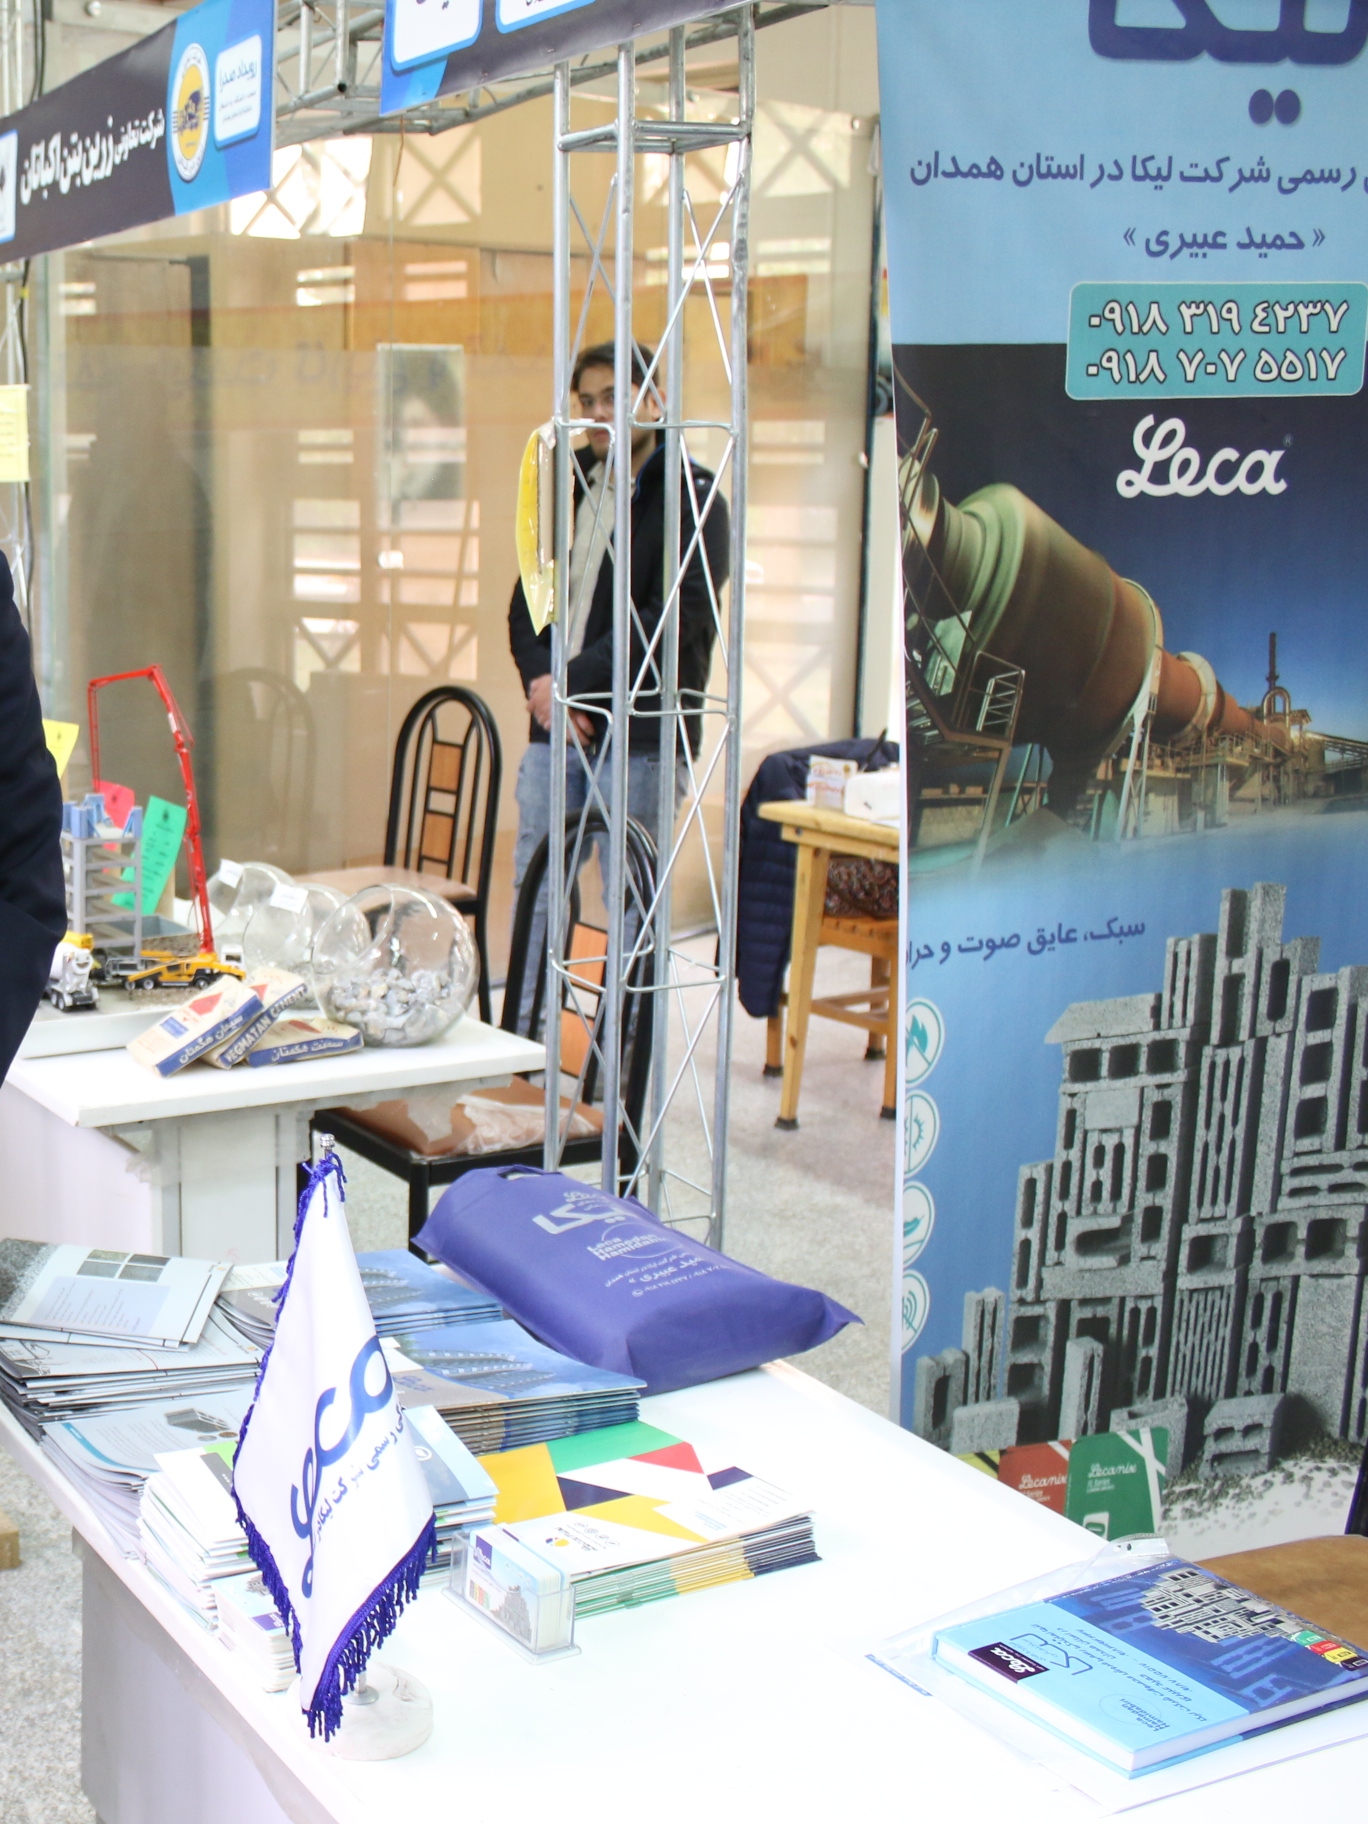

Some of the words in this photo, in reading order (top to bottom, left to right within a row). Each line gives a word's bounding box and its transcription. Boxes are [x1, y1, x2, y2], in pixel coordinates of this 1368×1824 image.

[114, 119, 139, 165] تعاونی
[139, 108, 165, 150] شرکت
[82, 115, 113, 186] زرین
[20, 132, 61, 205] اکباتان
[910, 151, 1004, 187] همدان
[1012, 153, 1084, 187] استان
[1090, 156, 1123, 189] در
[1132, 155, 1173, 190] لیکا
[1179, 155, 1271, 193] شرکت
[1277, 161, 1356, 195] رسمی
[1145, 227, 1227, 259] عبیری
[1236, 227, 1305, 259] حمید
[1088, 300, 1169, 335] ۰۹۱۸
[1179, 300, 1241, 335] ۳۱۹
[1086, 349, 1167, 384] ۰۹۱۸
[1178, 349, 1246, 383] ۷۰۷
[1254, 349, 1345, 383] ۵۵۱۷
[1116, 414, 1287, 498] Leca
[906, 941, 934, 970] حرا
[939, 941, 951, 965] و
[958, 932, 1020, 961] صوت
[1027, 923, 1077, 955] عایق
[270, 985, 307, 1018] CEMENT
[587, 1237, 622, 1251] Leca
[592, 1234, 658, 1256] Hamedan
[367, 1431, 397, 1470] رسمی
[1088, 1463, 1137, 1478] Lecanix
[990, 1647, 1036, 1674] Leca
[1010, 1632, 1094, 1676] لیکا
[1118, 1698, 1171, 1728] Hamidabiri
[1118, 1703, 1165, 1729] Hamedan
[1133, 1717, 1160, 1731] Leca
